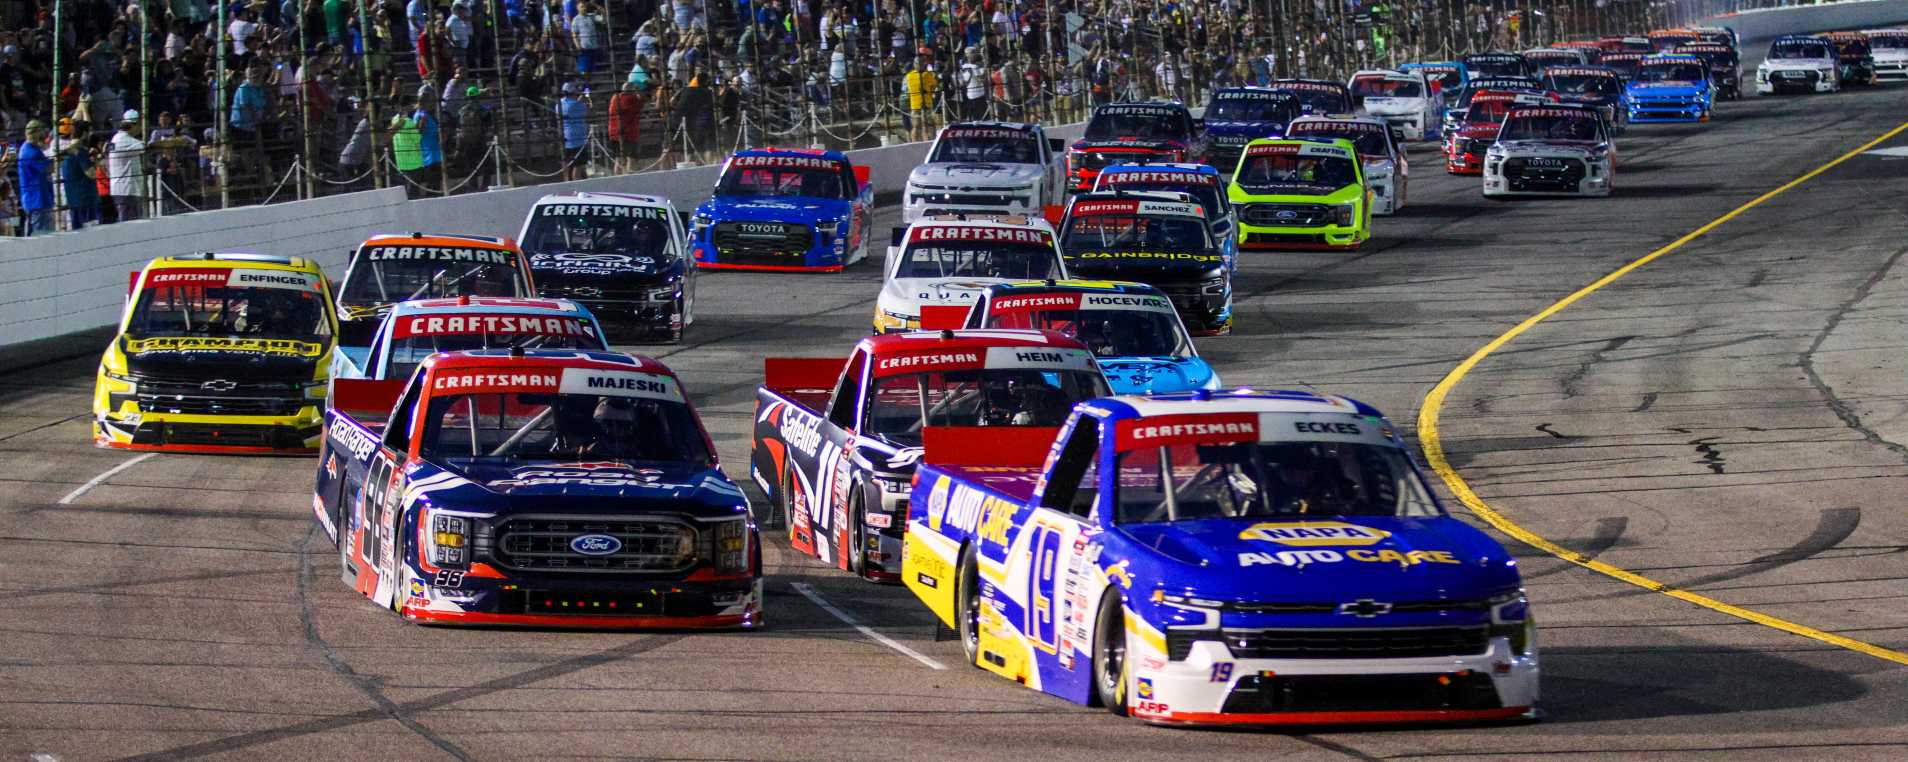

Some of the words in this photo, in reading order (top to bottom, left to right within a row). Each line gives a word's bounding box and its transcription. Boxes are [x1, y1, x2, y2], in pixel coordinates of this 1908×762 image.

[1642, 58, 1698, 66] CRAFTSMAN
[1549, 68, 1609, 77] CRAFTSMAN
[1270, 82, 1339, 93] CRAFTSMAN
[1470, 80, 1534, 89] CRAFTSMAN
[1217, 92, 1285, 101] CRAFTSMAN
[1100, 107, 1175, 117] CRAFTSMAN
[1515, 109, 1593, 119] CRAFTSMAN
[1297, 122, 1382, 132] CRAFTSMAN
[946, 129, 1029, 140] CRAFTSMAN
[1218, 136, 1248, 144] TOYOTA
[736, 157, 832, 169] CRAFTSMAN
[1527, 159, 1562, 167] TOYOTA
[1107, 172, 1212, 185] CRAFTSMAN
[542, 205, 657, 219] CRAFTSMAN
[1079, 204, 1134, 212] CRAFTSMAN
[1144, 204, 1190, 213] SANCHEZ
[741, 224, 785, 233] TOYOTA
[920, 228, 1042, 242] CRAFTSMAN
[369, 246, 507, 264] CRAFTSMAN
[1081, 252, 1223, 261] GAINBRIDGE
[153, 273, 226, 283] CRAFTSMAN
[240, 273, 307, 286] ENFINGER
[995, 296, 1075, 310] CRAFTSMAN
[1088, 296, 1162, 309] HOCEVAR
[410, 316, 584, 337] CRAFTSMAN
[879, 352, 978, 370] CRAFTSMAN
[1016, 351, 1064, 364] HEIM
[434, 373, 557, 389] CRAFTSMAN
[588, 375, 667, 394] MAJESKI
[780, 404, 823, 458] Safelite
[1132, 422, 1254, 440] CRAFTSMAN
[1296, 421, 1360, 436] ECKES
[945, 483, 986, 534] AUTO
[976, 495, 1016, 547] CARE
[1261, 527, 1372, 540] NAPA
[581, 536, 610, 551] Ford
[1238, 549, 1345, 568] AUTO
[1345, 548, 1462, 566] CARE
[1025, 522, 1064, 650] 19
[406, 596, 432, 608] ARP
[1208, 661, 1235, 683] 19
[1138, 700, 1169, 714] ARP
